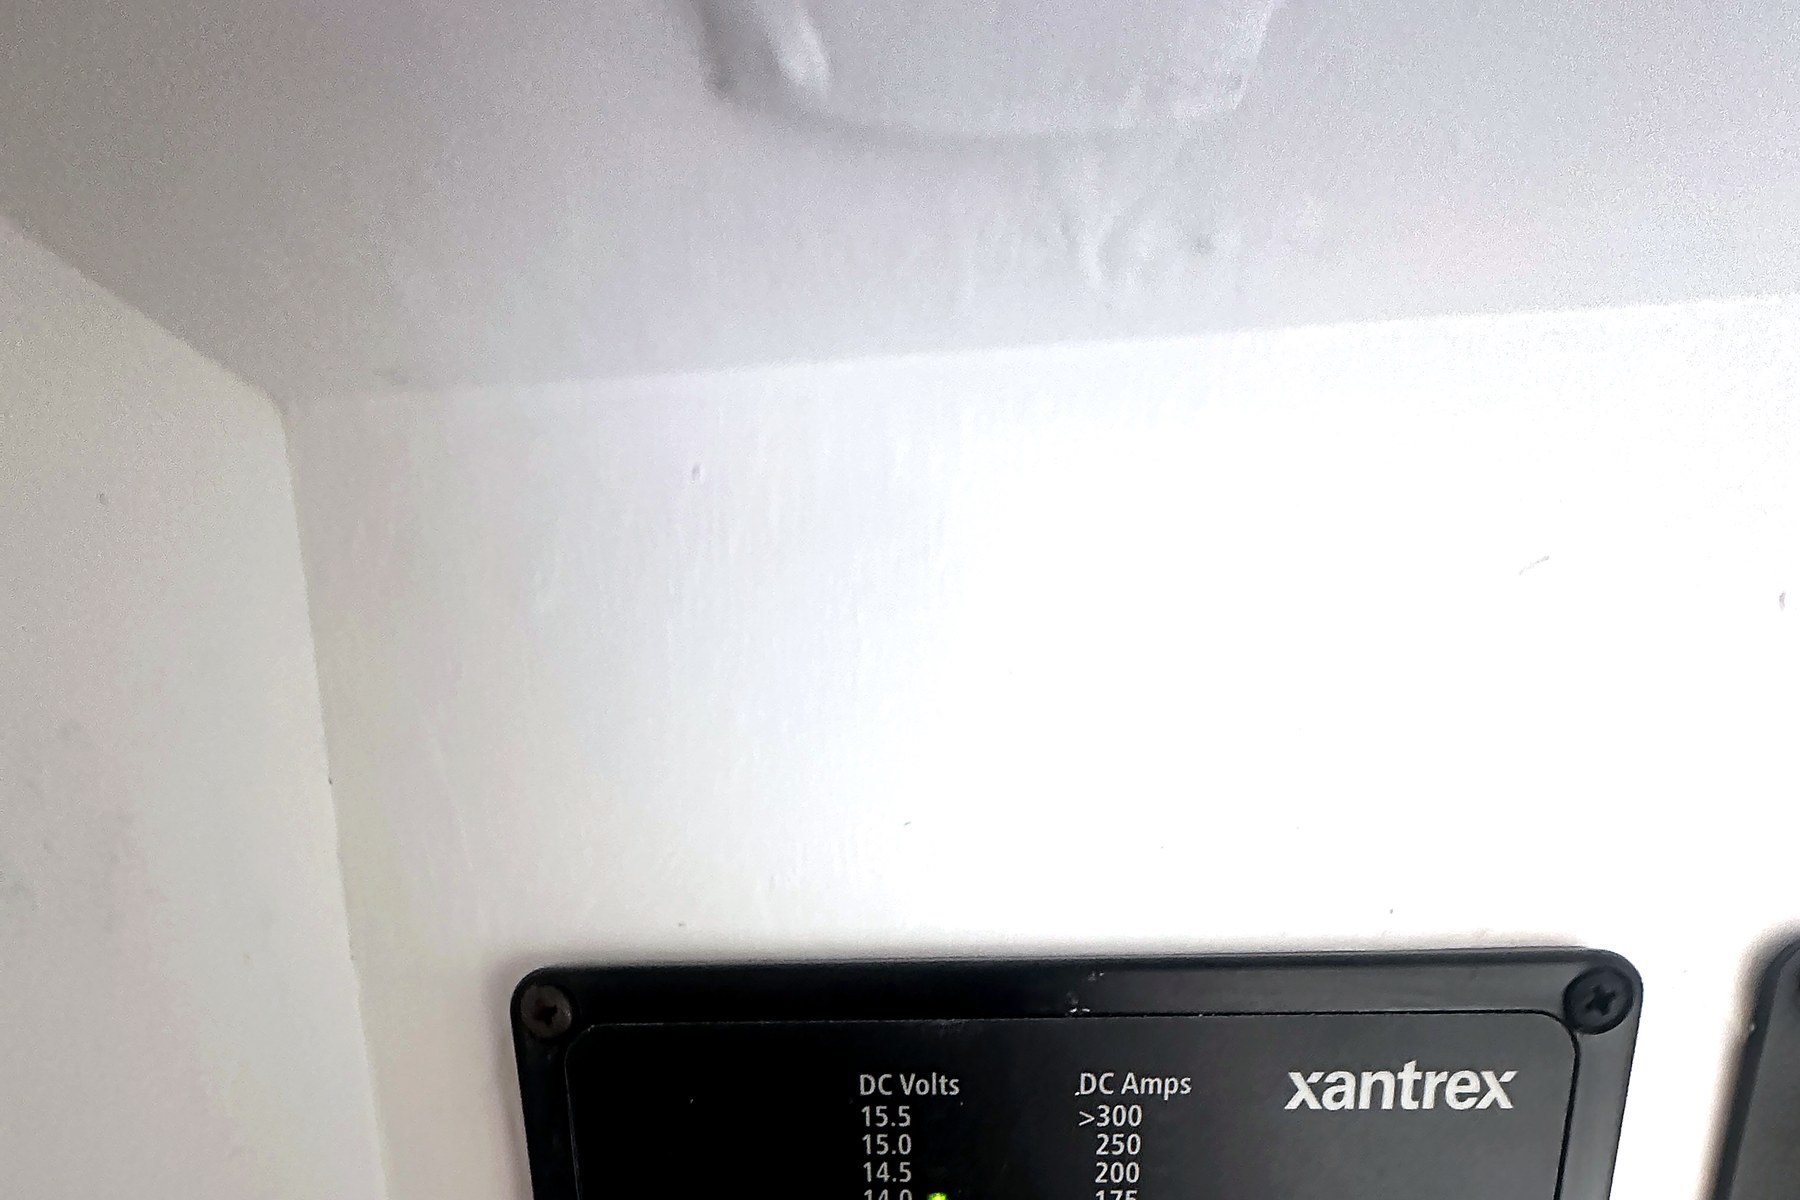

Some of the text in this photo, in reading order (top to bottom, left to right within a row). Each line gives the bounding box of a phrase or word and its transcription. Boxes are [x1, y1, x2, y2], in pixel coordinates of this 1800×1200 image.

[860, 1072, 959, 1095] DC Volts
[1079, 1073, 1191, 1100] DC Amps
[1285, 1061, 1517, 1110] xantrex
[862, 1106, 910, 1127] 15.5
[1079, 1105, 1142, 1126] >300
[863, 1134, 911, 1155] 15.0
[1096, 1134, 1140, 1155] 250
[864, 1162, 911, 1182] 14.5
[1095, 1162, 1139, 1183] 200
